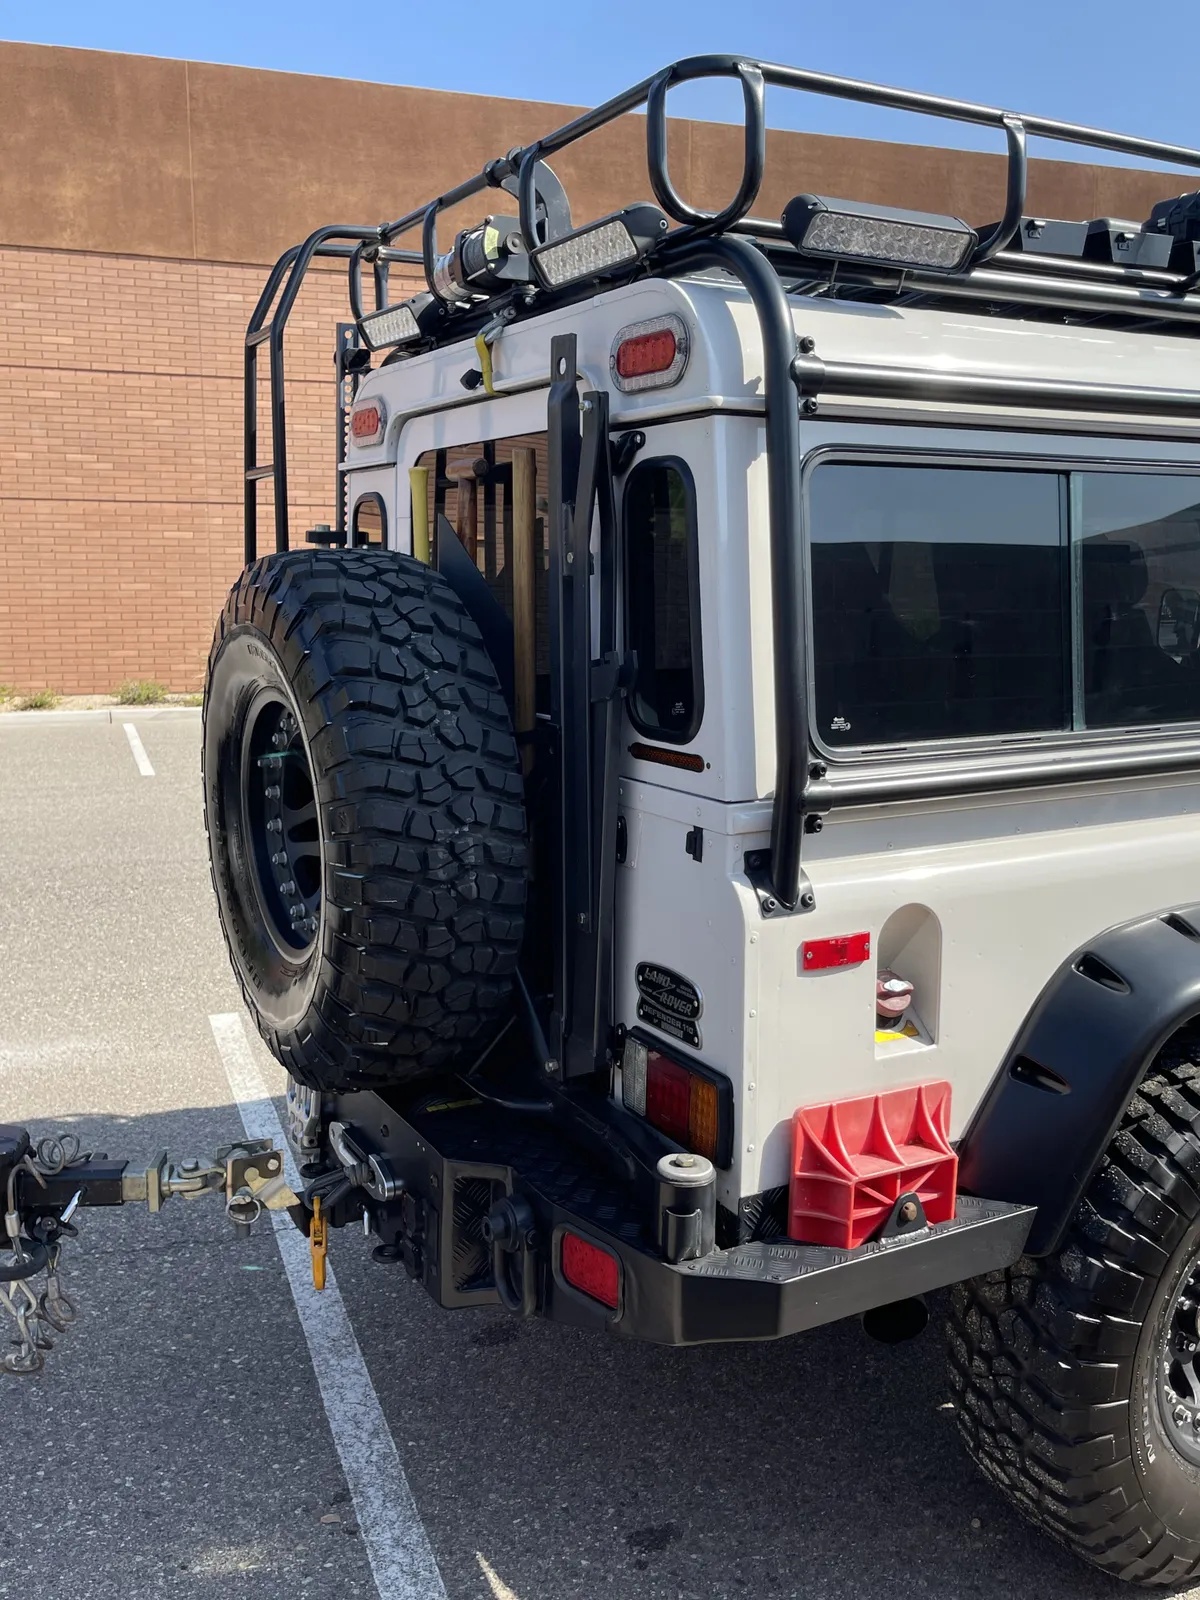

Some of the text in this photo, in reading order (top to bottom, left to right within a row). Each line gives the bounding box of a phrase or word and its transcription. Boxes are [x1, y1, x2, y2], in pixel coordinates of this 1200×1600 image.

[644, 967, 670, 988] LAND
[660, 991, 693, 1016] ROVER
[642, 1003, 682, 1029] DEFENDER
[682, 1023, 694, 1035] 110
